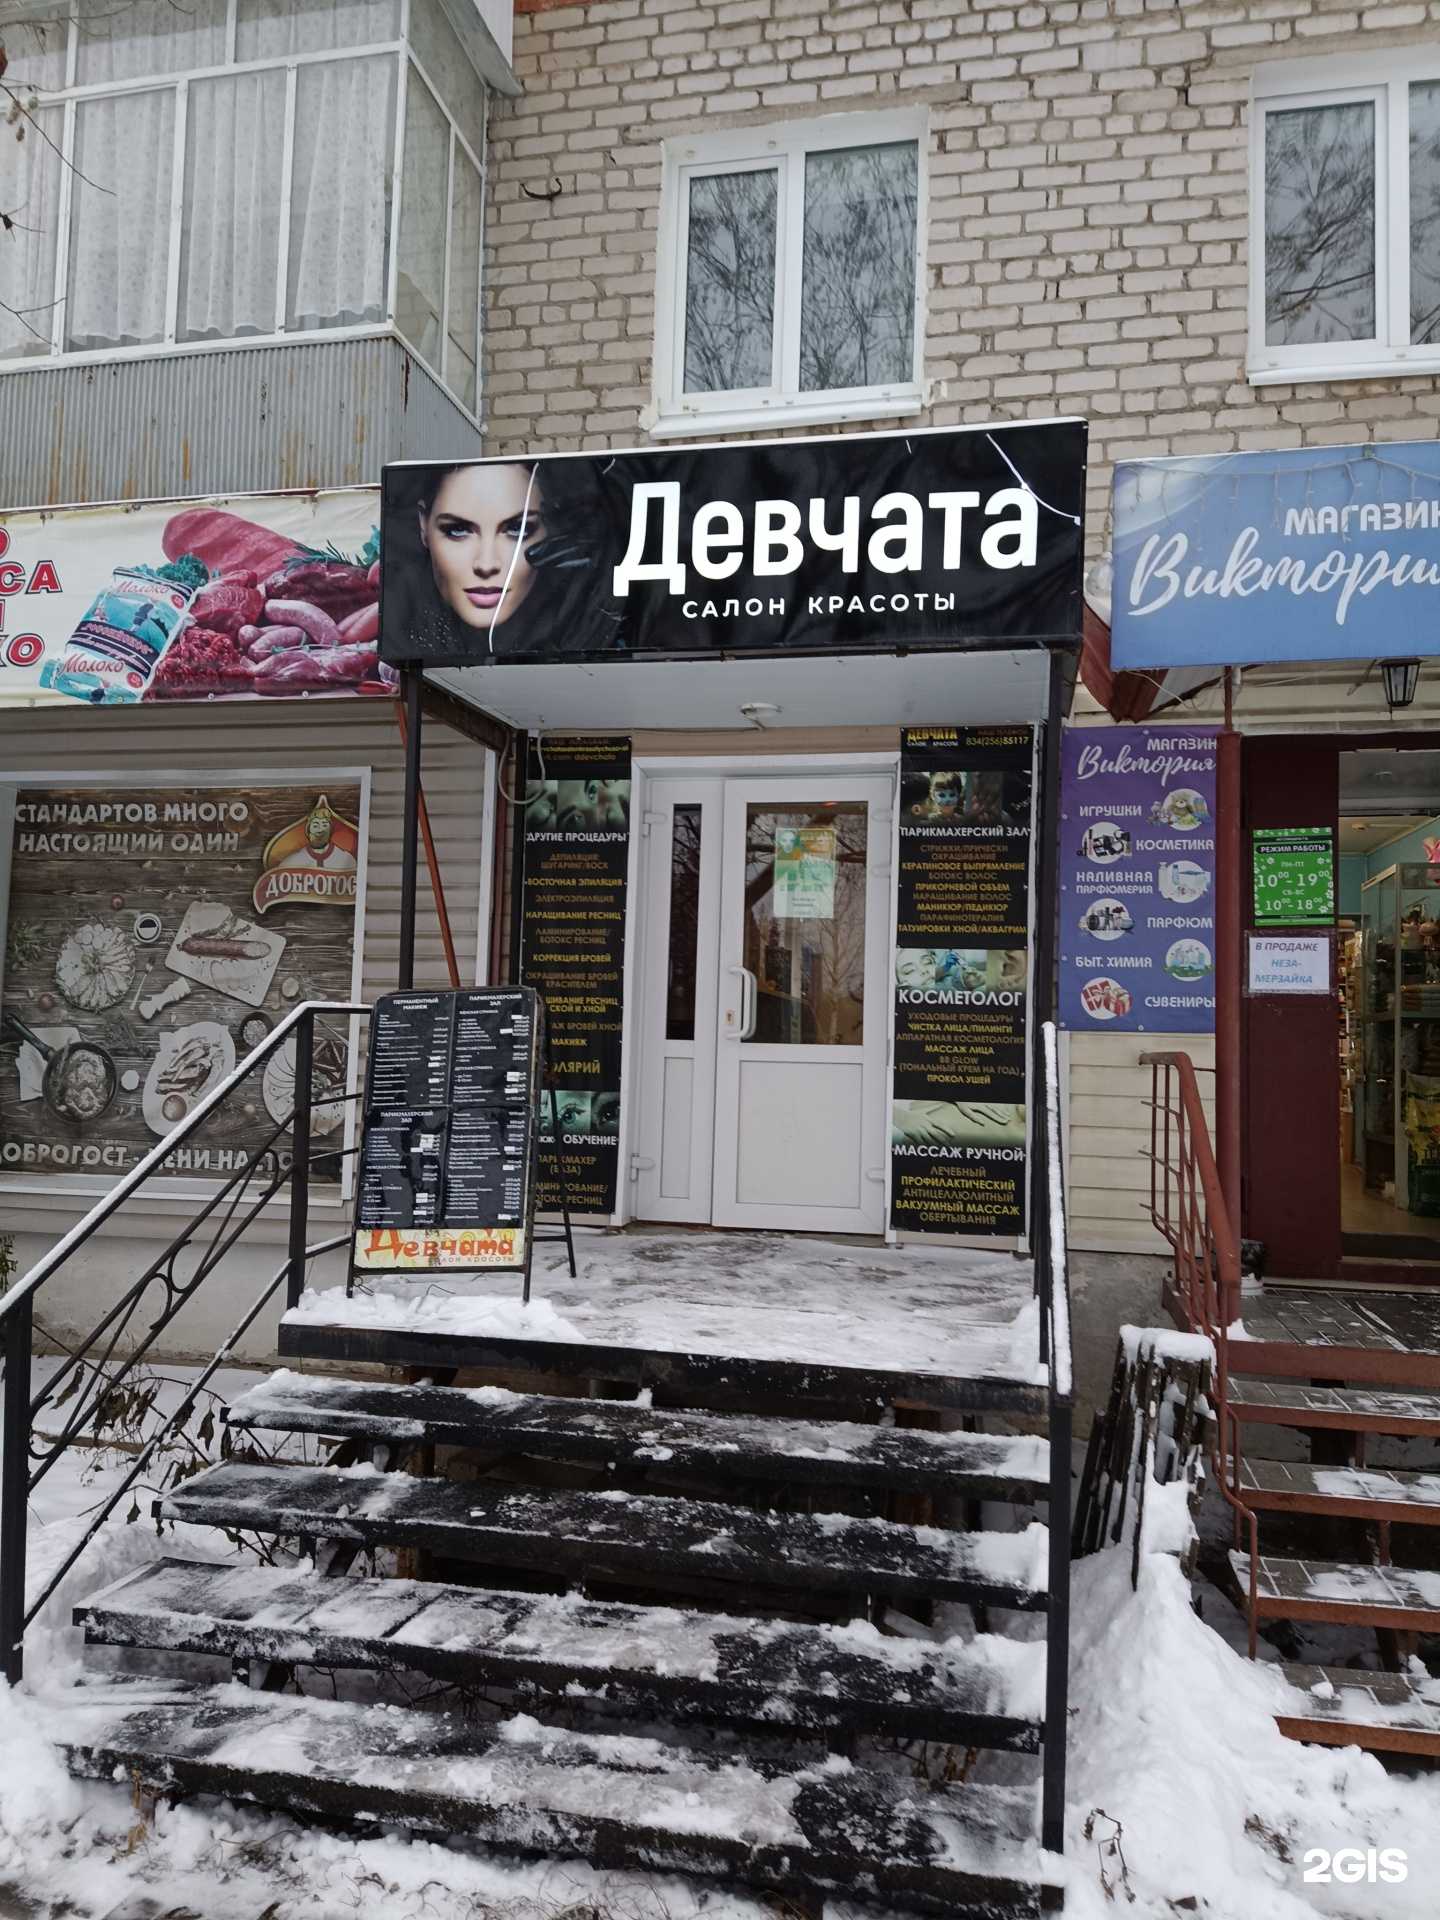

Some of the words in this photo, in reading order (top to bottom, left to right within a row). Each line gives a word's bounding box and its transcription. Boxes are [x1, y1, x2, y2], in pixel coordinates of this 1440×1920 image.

[613, 481, 1038, 597] Девчата
[1128, 526, 1440, 626] Виктори
[682, 598, 785, 619] САЛОН
[808, 592, 955, 614] КРАСОТЫ
[61, 653, 124, 673] Молоко
[1147, 737, 1217, 752] МАГАЗИН
[1076, 744, 1216, 787] Виктория
[15, 803, 157, 825] СТАНДАРТОВ
[164, 802, 249, 821] МНОГО
[1080, 805, 1142, 817] ИГРУШКИ
[527, 832, 564, 842] ДРУГИЕ
[565, 832, 627, 843] ПРОЦЕДУРЫ
[900, 825, 1004, 838] ПАРИКМАХЕРСКИЙ
[1006, 826, 1028, 838] ЗАЛ
[171, 833, 239, 854] ОДИН
[1136, 839, 1215, 851] КОСМЕТИКА
[1260, 845, 1291, 854] РЕЖИМ
[1292, 844, 1326, 853] РАБОТЫ
[902, 862, 961, 871] КЕРАТИНОВОЕ
[527, 878, 577, 886] ВОСТОЧНАЯ
[1076, 871, 1153, 883] НАЛИВНАЯ
[1076, 884, 1153, 895] ПАРФЮМЕРИЯ
[1147, 916, 1213, 929] ПАРФЮМ
[1255, 942, 1262, 951] В
[1264, 942, 1320, 952] ПРОДАЖЕ
[1075, 956, 1104, 968] БЫТ.
[1107, 957, 1153, 968] ХИМИЯ
[1271, 959, 1303, 968] НЕЗА-
[899, 989, 1023, 1007] КОСМЕТОЛОГ
[1144, 996, 1216, 1008] СУВЕНИРЫ
[924, 1044, 967, 1054] МАССАЖ
[968, 1046, 995, 1055] ЛИЦА
[563, 1134, 617, 1146] ОБУЧЕНИЕ
[0, 1143, 128, 1166] ОБРОГОСТ
[894, 1144, 962, 1159] МАССАЖ
[966, 1147, 1024, 1162] РУЧНОЙ
[930, 1166, 987, 1178] ЛЕЧЕБНЫЙ
[901, 1175, 1016, 1191] ПРОФИЛАКТИЧЕСКИЙ
[902, 1188, 1015, 1203] АНТИЦЕЛЛЮЛИТНЫЙ
[895, 1199, 964, 1212] ВАКУУМНЫЙ
[966, 1203, 1020, 1216] МАССАЖ
[920, 1212, 997, 1225] ОБЕРТЫВАНИЯ
[364, 1228, 514, 1261] Девчата
